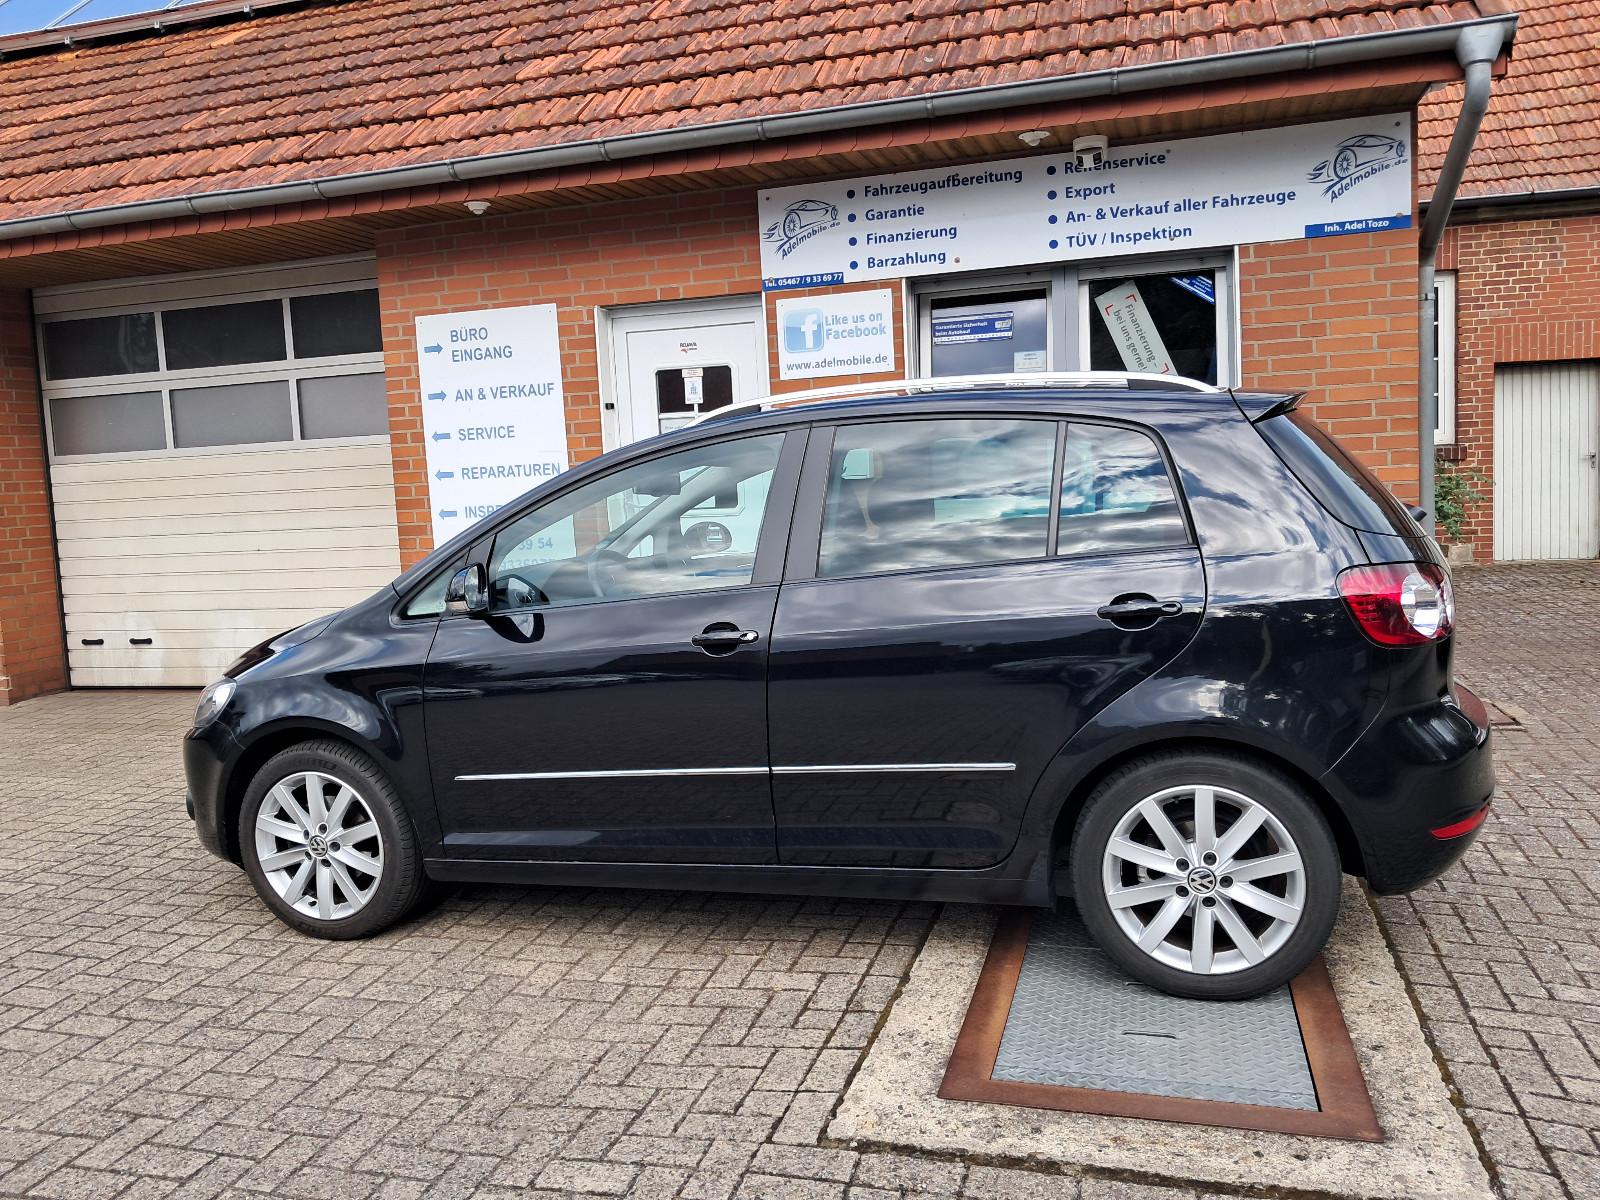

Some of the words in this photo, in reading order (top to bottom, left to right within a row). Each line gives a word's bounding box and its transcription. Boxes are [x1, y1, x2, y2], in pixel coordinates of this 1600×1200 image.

[1064, 153, 1166, 174] Renservice
[864, 170, 1023, 198] Fahrzeugaufbereitung
[1330, 158, 1408, 203] Adelmobile.de
[1065, 182, 1116, 200] Export
[865, 204, 925, 222] Garantie
[1065, 210, 1092, 223] An-
[1095, 207, 1107, 221] &
[1109, 200, 1169, 219] Verkauf
[1173, 198, 1208, 213] aller
[1212, 190, 1297, 209] Fahrzeuge
[866, 225, 958, 245] Finanzierung
[1324, 224, 1342, 233] Inh.
[1344, 221, 1366, 231] Adel
[1367, 219, 1389, 228] Tozo
[781, 221, 841, 260] Adelmobile.de
[1066, 232, 1097, 248] TÜV
[1101, 232, 1107, 245] /
[1110, 225, 1192, 244] Inspektion
[867, 251, 947, 269] Barzahlung
[777, 277, 801, 286] 05467
[806, 276, 811, 284] 9
[812, 275, 822, 283] 33
[822, 274, 832, 282] 69
[833, 273, 843, 281] 77
[825, 314, 849, 326] Like
[852, 314, 866, 324] us
[869, 312, 883, 321] on
[1113, 309, 1125, 326] bei
[450, 326, 489, 343] BÜRO
[825, 323, 887, 340] Facebook
[1121, 325, 1132, 342] uns
[1125, 303, 1156, 363] Finanzierung
[451, 345, 513, 363] EINGANG
[786, 353, 888, 371] www.adelmobile.de
[1126, 341, 1148, 371] gerne!
[454, 388, 474, 402] AN
[477, 387, 487, 401] &
[490, 382, 555, 399] VERKAUF
[457, 425, 516, 441] SERVICE
[461, 462, 561, 480] REPARATUREN
[464, 504, 503, 519] INSP
[537, 536, 554, 549] 54
